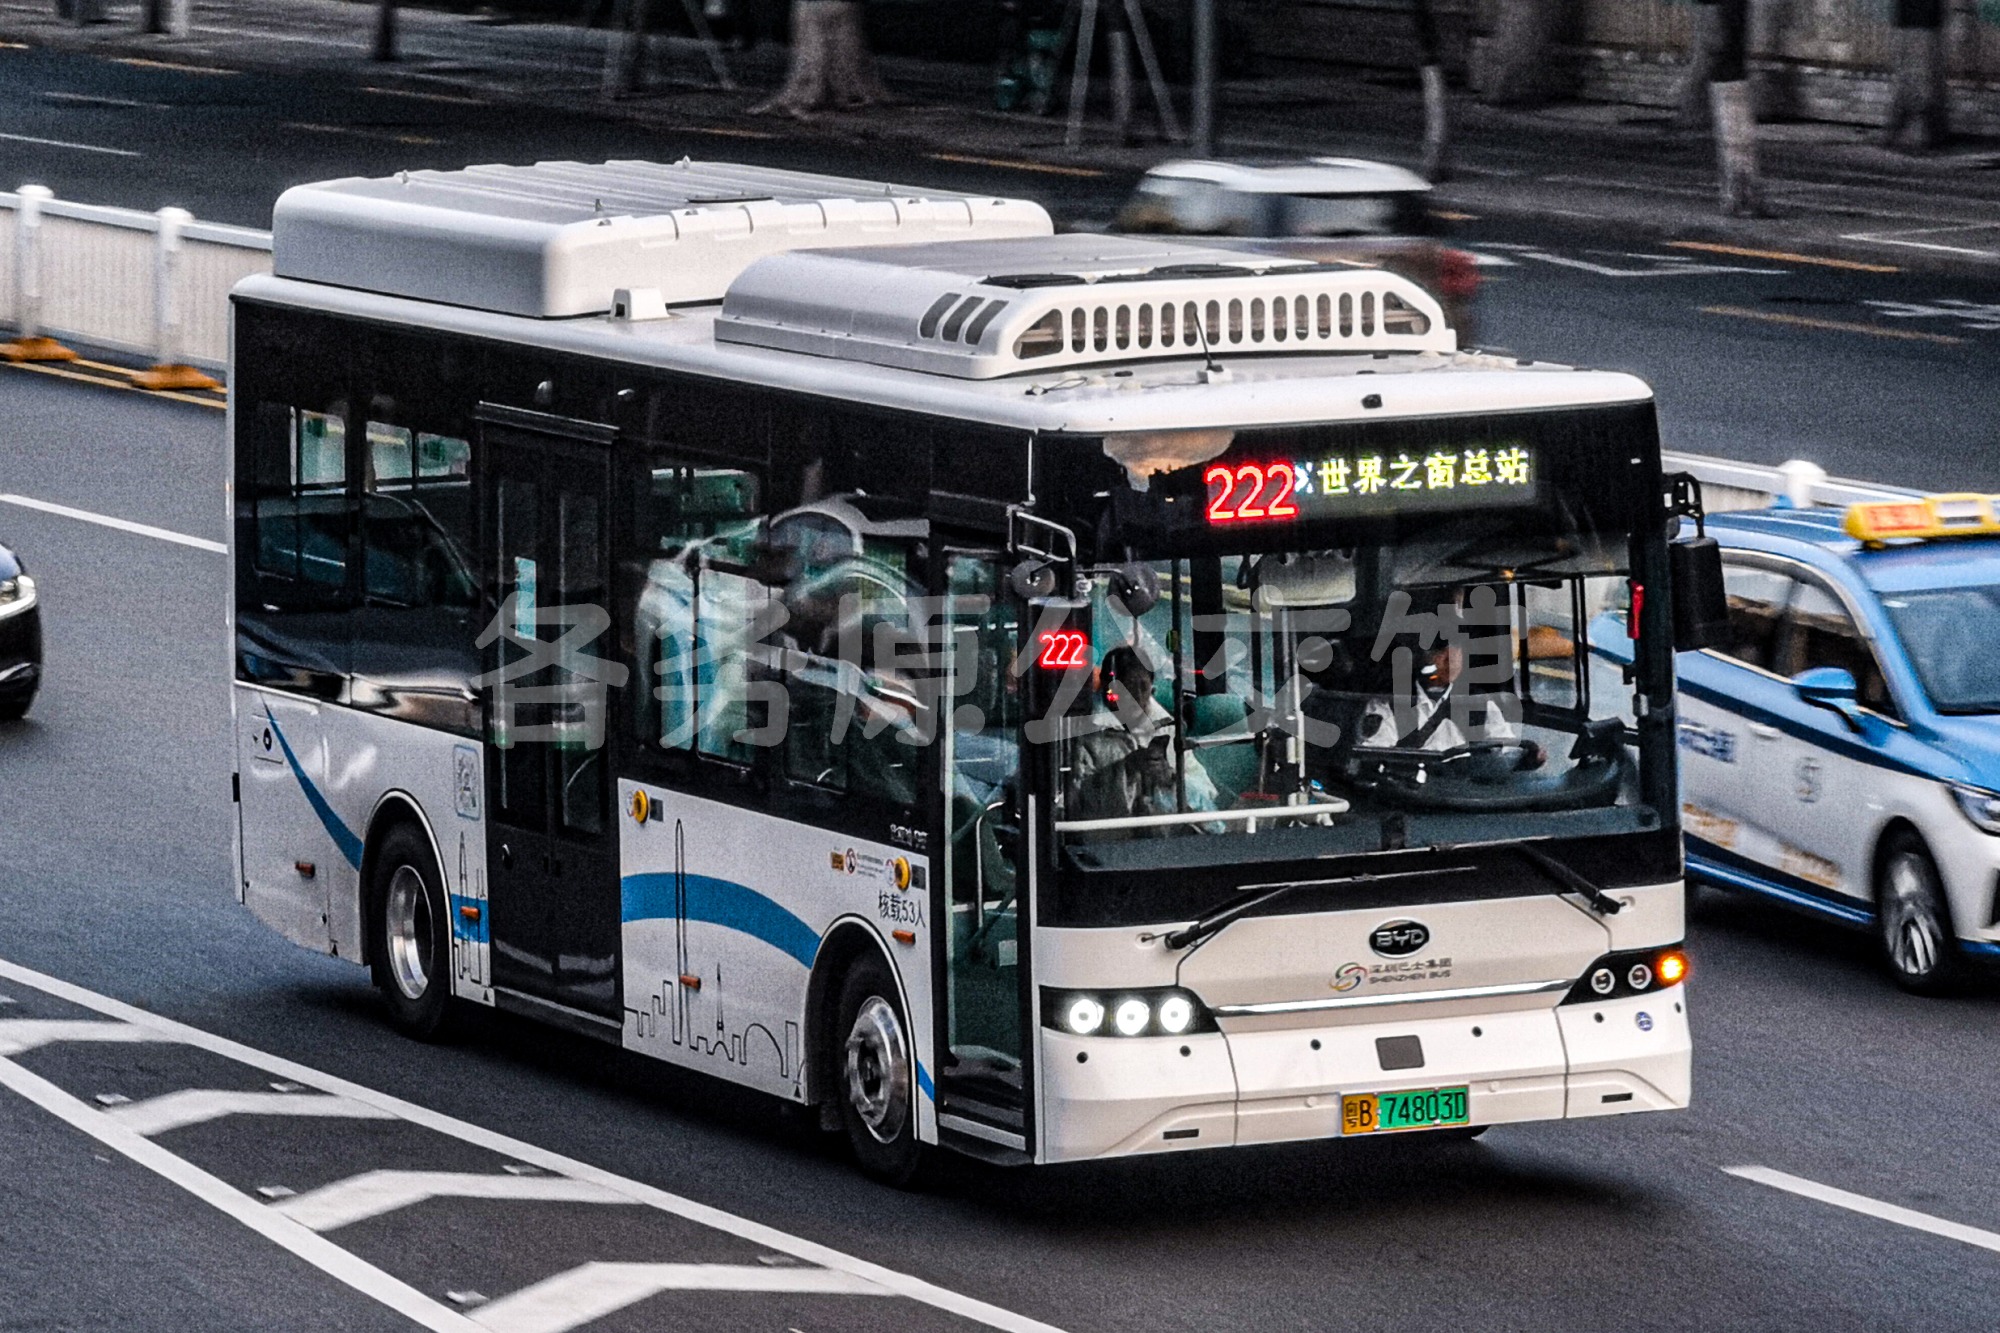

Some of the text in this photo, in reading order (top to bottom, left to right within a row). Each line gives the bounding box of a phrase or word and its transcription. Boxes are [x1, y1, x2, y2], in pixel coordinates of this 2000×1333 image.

[1204, 462, 1299, 523] 222
[1316, 446, 1530, 496] 世界之窗总站
[1039, 631, 1087, 668] 222
[1376, 928, 1426, 948] BYD
